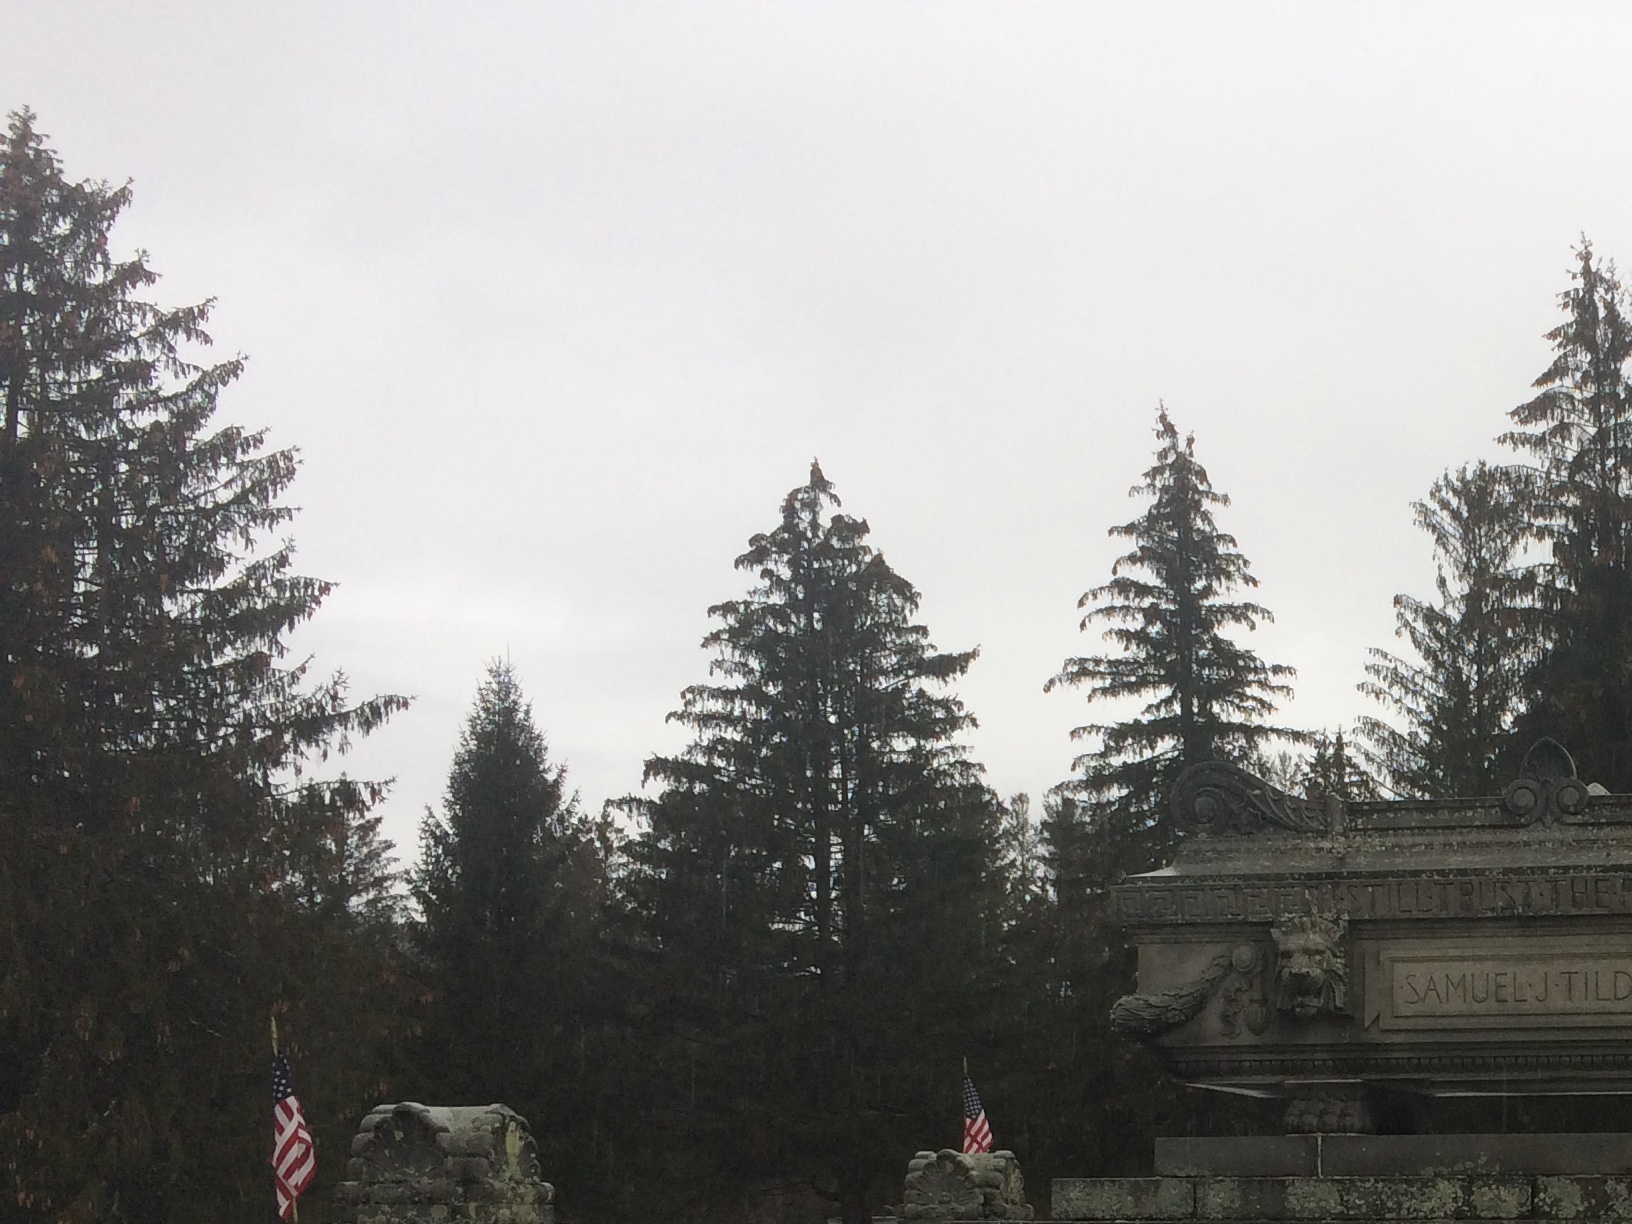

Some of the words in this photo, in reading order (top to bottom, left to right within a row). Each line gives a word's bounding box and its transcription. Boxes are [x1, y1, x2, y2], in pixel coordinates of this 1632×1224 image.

[1346, 883, 1432, 915] STILL
[1433, 880, 1538, 912] TRUST
[1544, 877, 1610, 908] THE
[1404, 972, 1528, 1004] SAMUEL
[1534, 971, 1549, 1003] J
